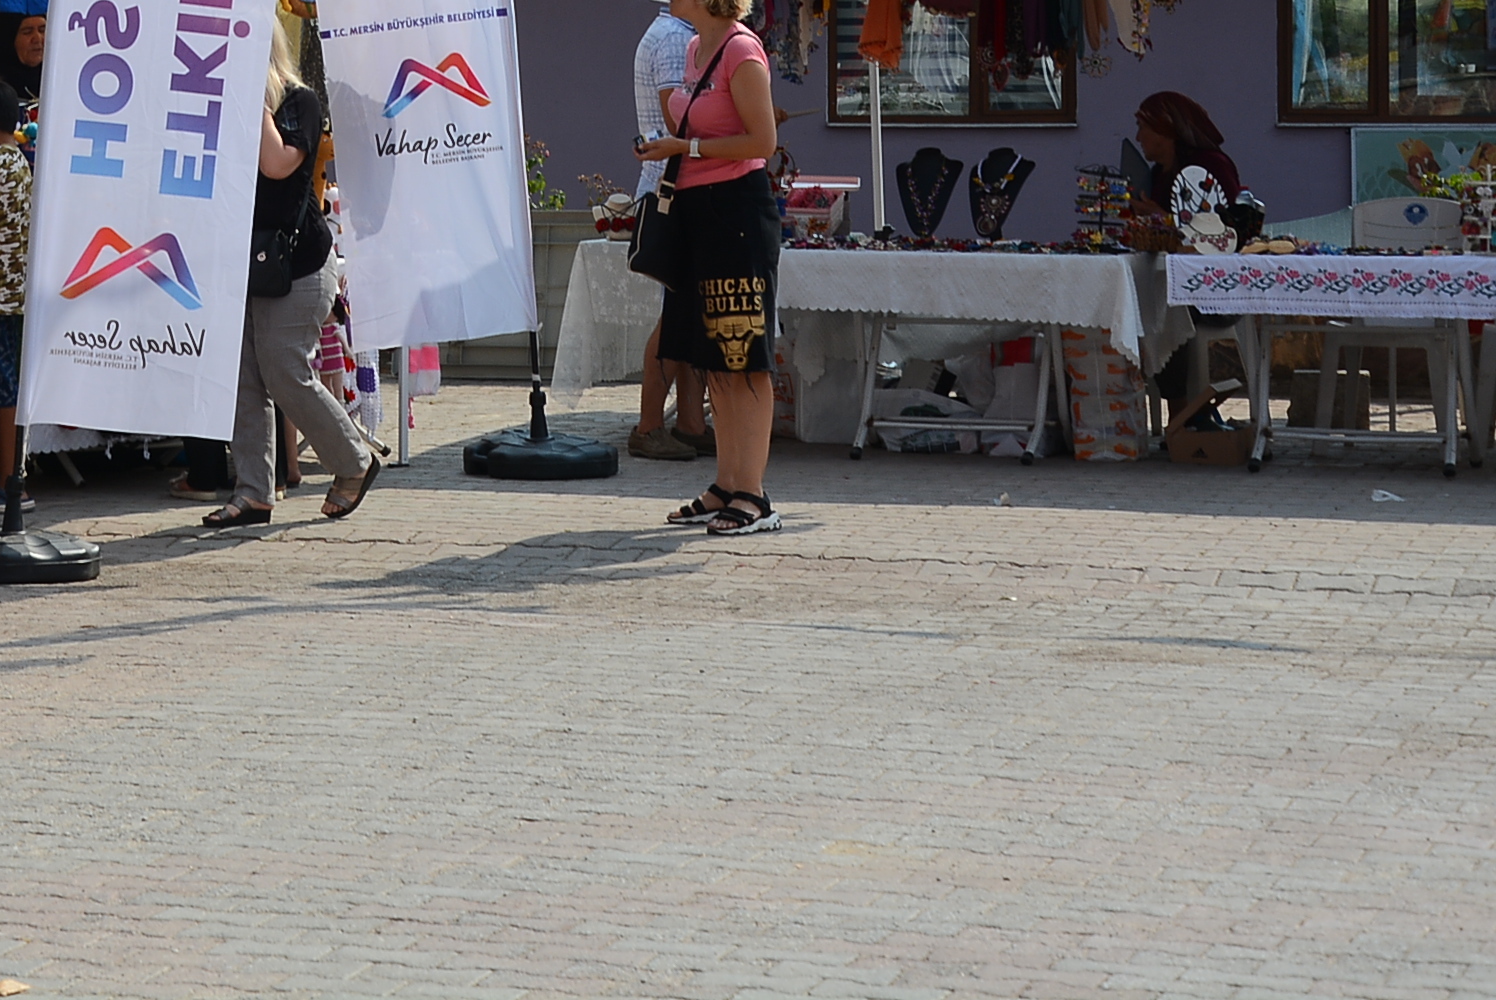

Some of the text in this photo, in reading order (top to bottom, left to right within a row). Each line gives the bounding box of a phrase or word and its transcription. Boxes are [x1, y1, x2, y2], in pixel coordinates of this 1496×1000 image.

[333, 6, 495, 38] T.C. MERSİN BÜYÜKŞEHİR BELEDİYESİ
[375, 122, 493, 165] Vahap Seçer
[698, 276, 766, 296] CHICAGO
[705, 295, 763, 313] BULLS
